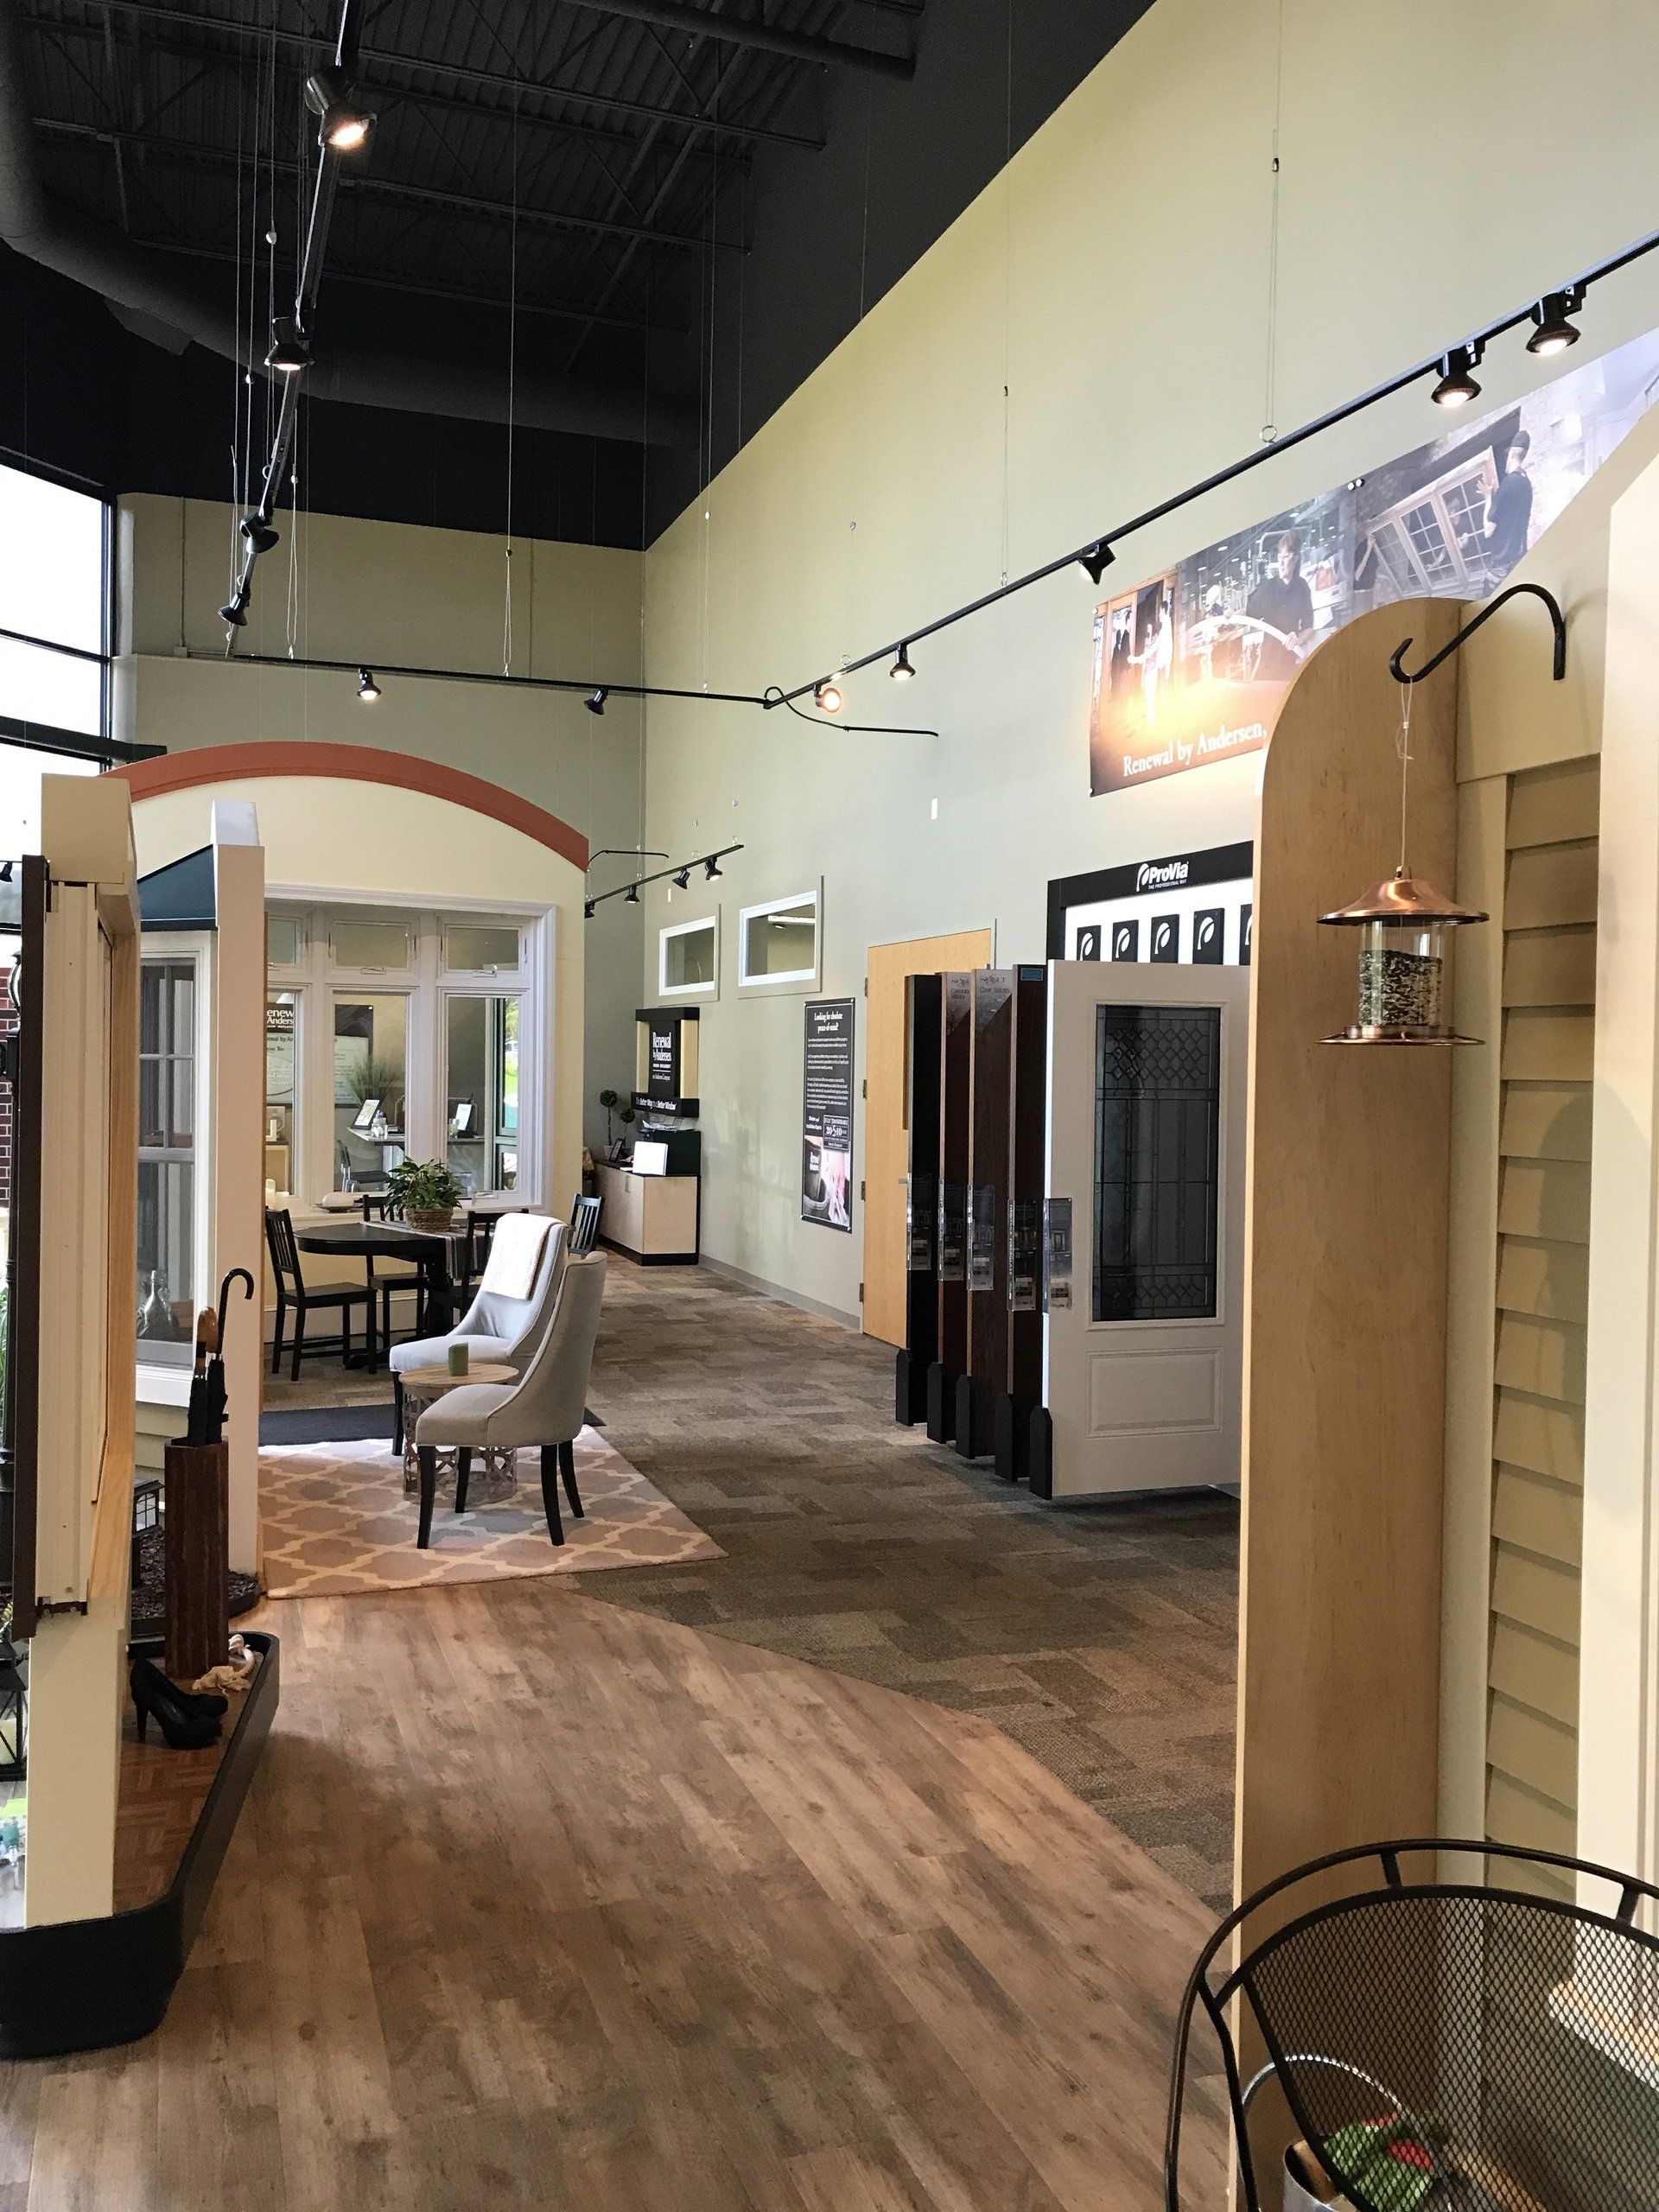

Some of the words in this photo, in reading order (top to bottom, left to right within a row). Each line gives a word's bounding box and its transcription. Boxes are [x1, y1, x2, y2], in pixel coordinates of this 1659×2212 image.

[1122, 741, 1174, 777] Renewal
[1177, 738, 1194, 766] by
[1148, 861, 1189, 885] ProVia
[266, 1009, 294, 1018] enew
[266, 1017, 294, 1026] Anders
